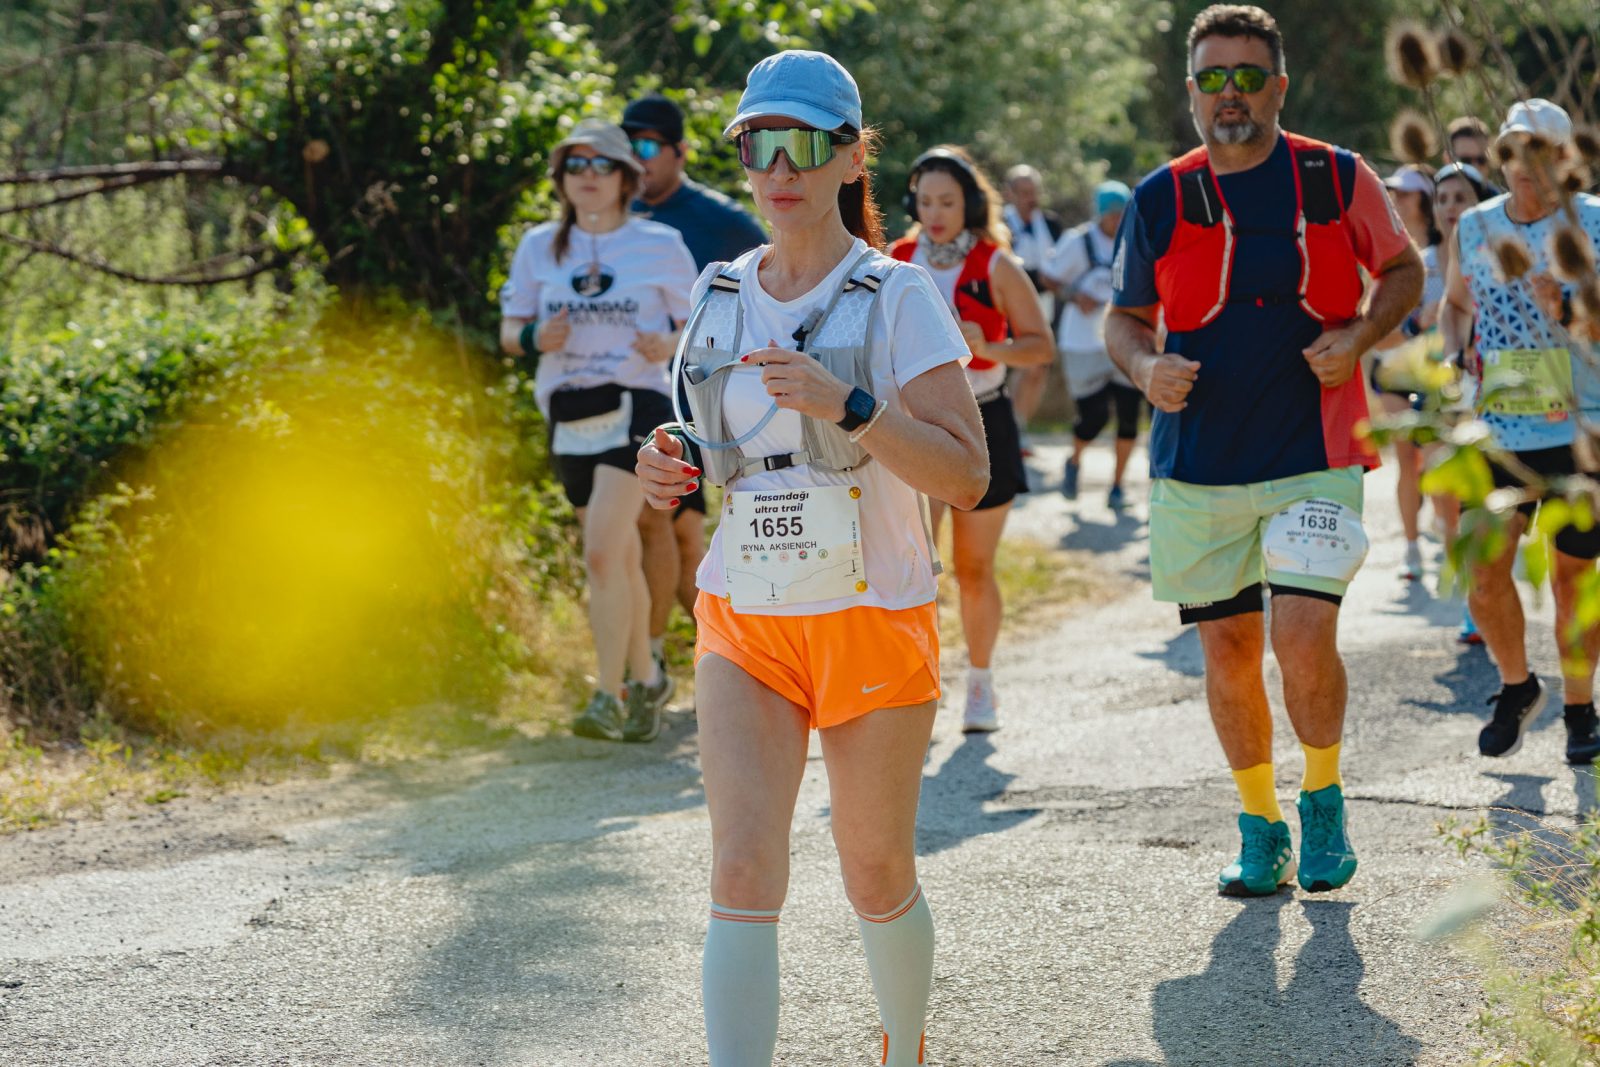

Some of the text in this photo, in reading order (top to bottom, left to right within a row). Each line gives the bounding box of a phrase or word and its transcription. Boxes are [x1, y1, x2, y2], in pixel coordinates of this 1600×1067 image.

[754, 491, 809, 502] Hasandağı
[755, 503, 803, 514] ultra trail
[750, 516, 803, 538] 1655
[1299, 514, 1337, 531] 1638
[740, 541, 817, 552] IRYNA AKSIENICH
